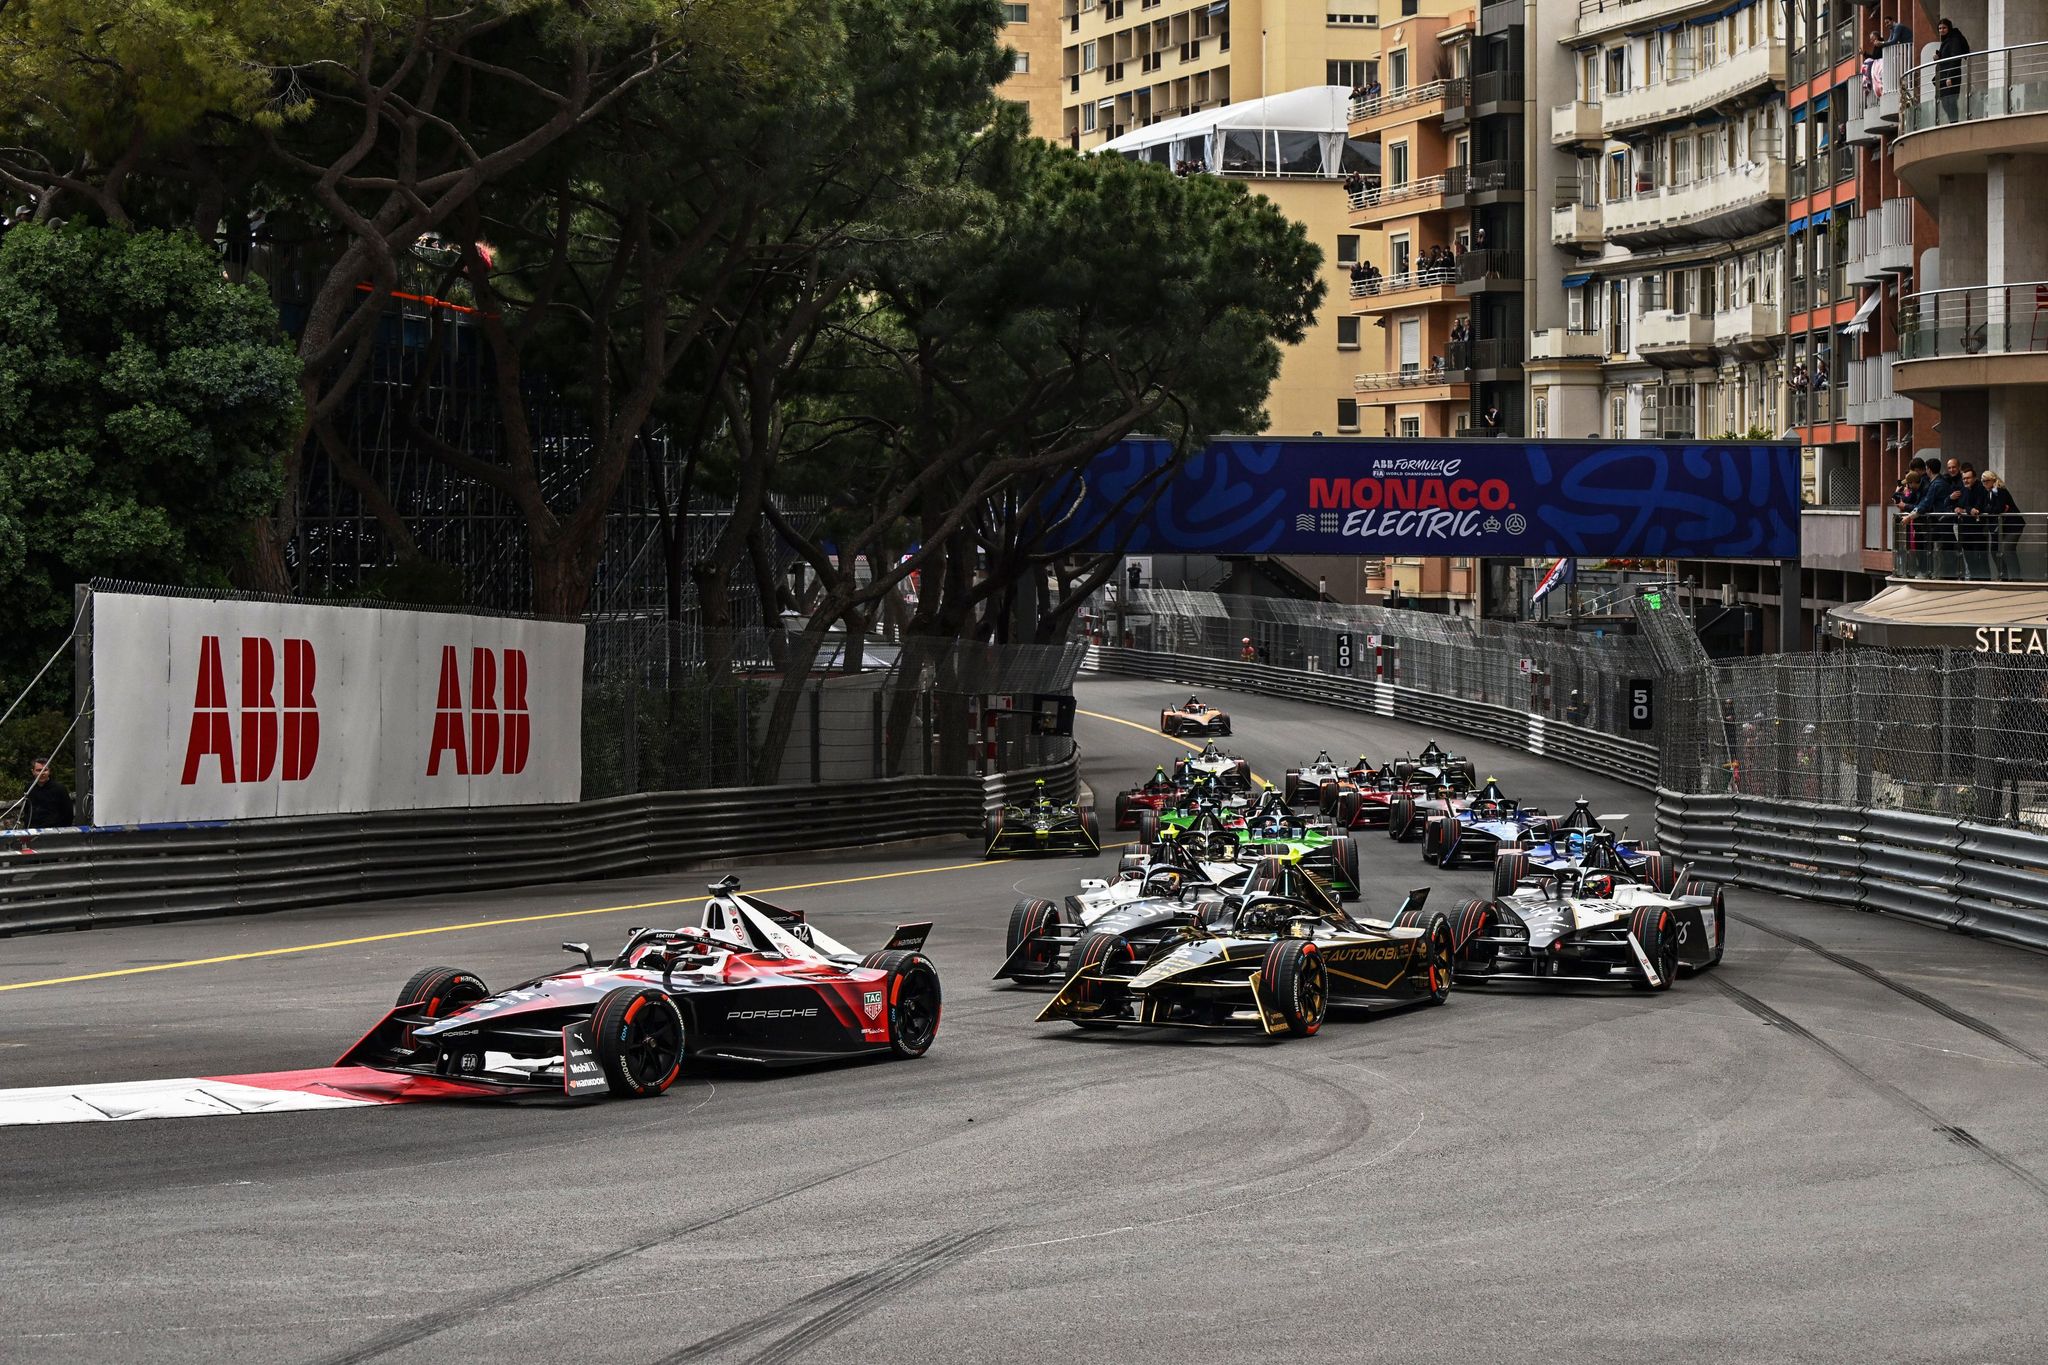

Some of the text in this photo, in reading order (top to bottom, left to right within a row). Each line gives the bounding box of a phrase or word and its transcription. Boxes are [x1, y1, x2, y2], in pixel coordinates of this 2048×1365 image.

[1372, 459, 1394, 469] ABB
[1394, 459, 1445, 470] FORMULA
[1975, 627, 2048, 657] STEA
[180, 635, 320, 785] ABB
[426, 645, 531, 776] ABB
[865, 993, 881, 1003] TAG
[726, 1008, 819, 1020] PORSCHE
[442, 1029, 479, 1038] PORSCHE
[570, 1062, 590, 1074] Mobil
